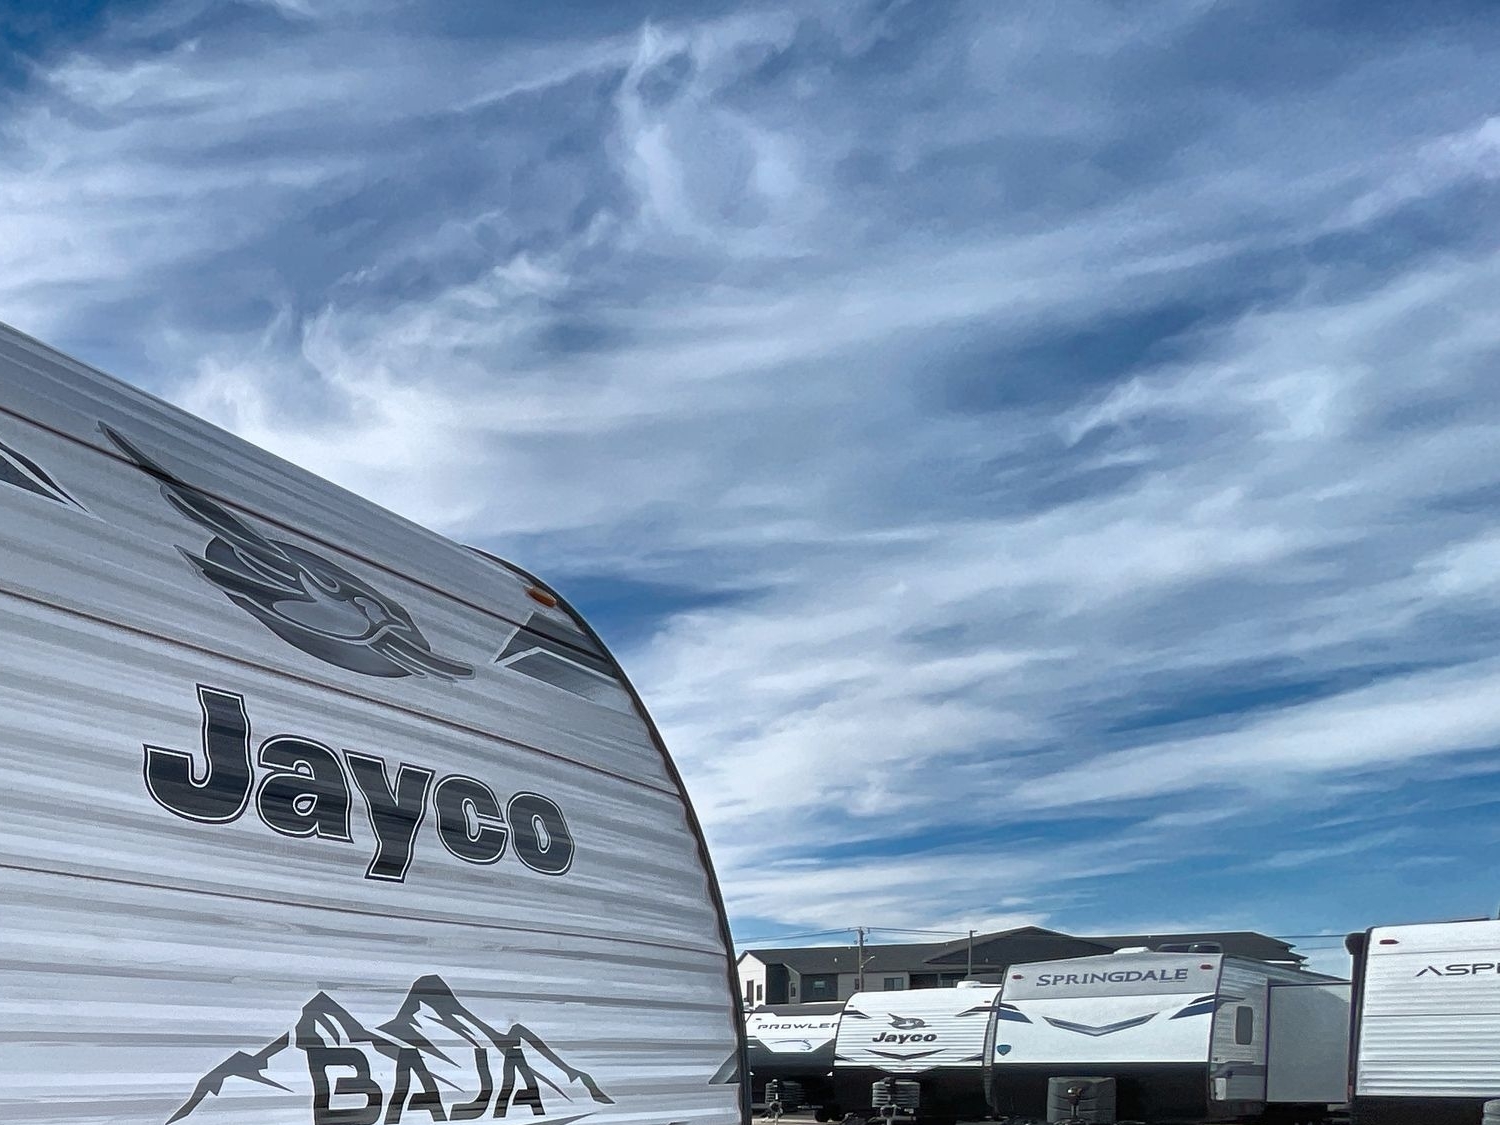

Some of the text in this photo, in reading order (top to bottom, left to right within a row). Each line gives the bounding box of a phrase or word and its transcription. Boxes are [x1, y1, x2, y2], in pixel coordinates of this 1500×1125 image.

[143, 683, 575, 883] Jayco
[1036, 968, 1189, 987] SPRINGDALE
[1415, 962, 1500, 977] ASP
[872, 1031, 938, 1045] Jayco
